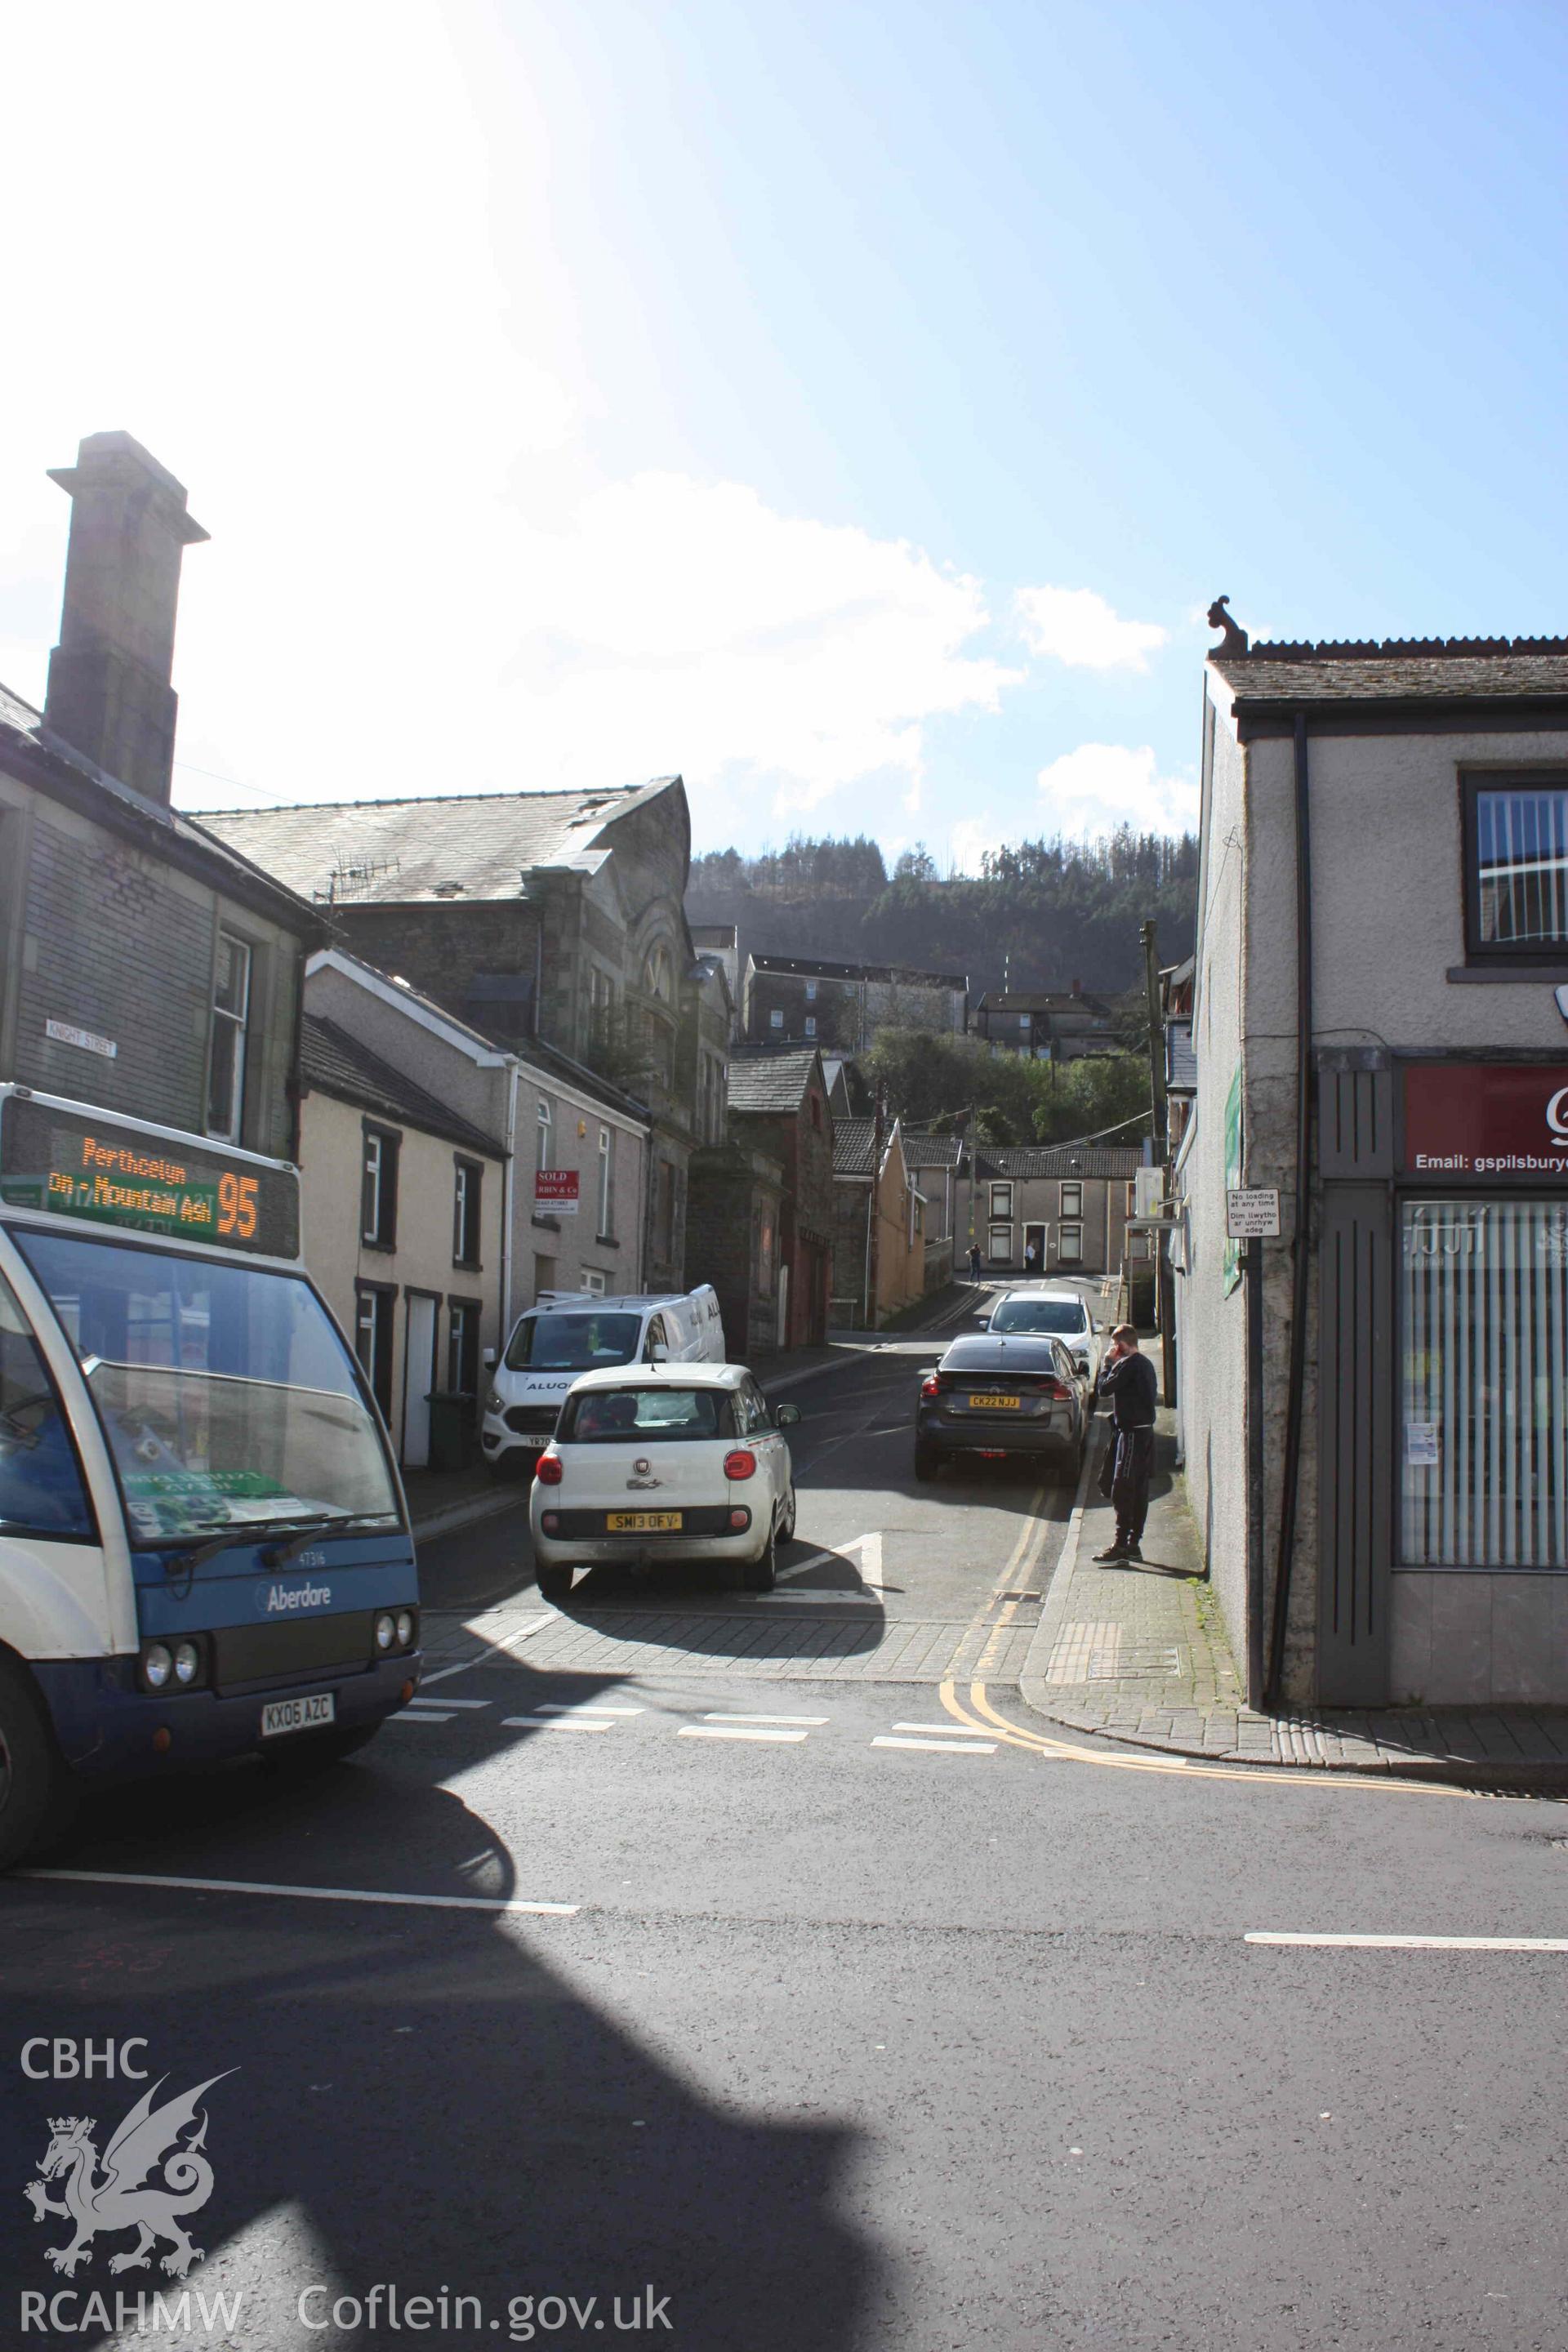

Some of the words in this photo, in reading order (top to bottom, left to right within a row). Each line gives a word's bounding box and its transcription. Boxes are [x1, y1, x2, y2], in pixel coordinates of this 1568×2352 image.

[49, 1022, 80, 1045] KNIGHT
[84, 1032, 113, 1054] STREET
[83, 1138, 186, 1185] Perthcelyn
[538, 1172, 567, 1181] SOLD
[1415, 1154, 1468, 1169] Email:
[95, 1175, 176, 1215] Mountain
[180, 1195, 212, 1223] Ash
[217, 1172, 259, 1238] 95
[973, 1396, 996, 1405] CK22
[999, 1396, 1017, 1406] NJJ
[616, 1515, 644, 1528] SM13
[648, 1515, 673, 1527] OFV
[299, 1551, 326, 1566] 47316
[267, 1582, 331, 1612] Aberdare
[265, 1702, 301, 1731] KX06
[305, 1696, 329, 1722] AZC
